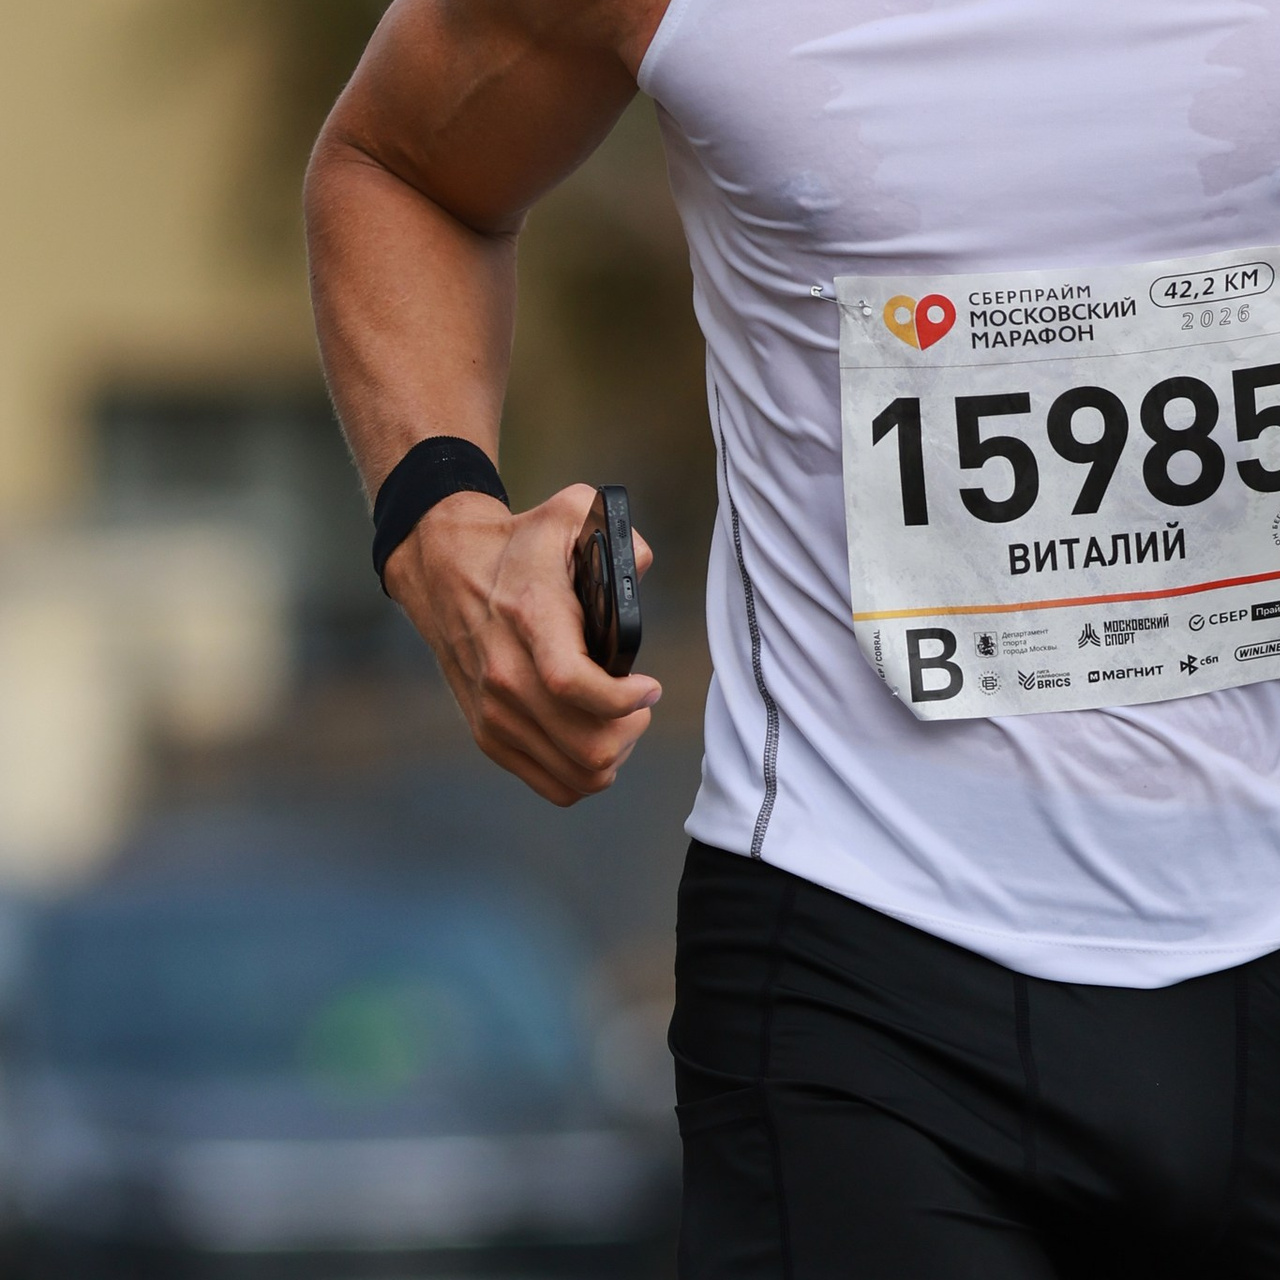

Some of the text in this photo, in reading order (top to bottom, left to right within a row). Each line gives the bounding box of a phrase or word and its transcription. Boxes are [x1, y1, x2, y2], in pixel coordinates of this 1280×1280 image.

[969, 284, 1091, 306] СБЕРПРАЙМ
[1164, 276, 1215, 300] 42,2
[970, 297, 1137, 328] МОСКОВСКИЙ
[1181, 304, 1250, 331] 2026
[971, 324, 1095, 350] МАРАФОН
[1008, 521, 1187, 576] ВИТАЛИЙ
[1103, 613, 1170, 634] МОСКОВСКИЙ
[1208, 609, 1248, 625] СБЕР
[1001, 628, 1049, 640] Департамент
[1002, 639, 1027, 648] спорта
[1104, 631, 1136, 647] СПОРТ
[1037, 677, 1072, 689] BRICS
